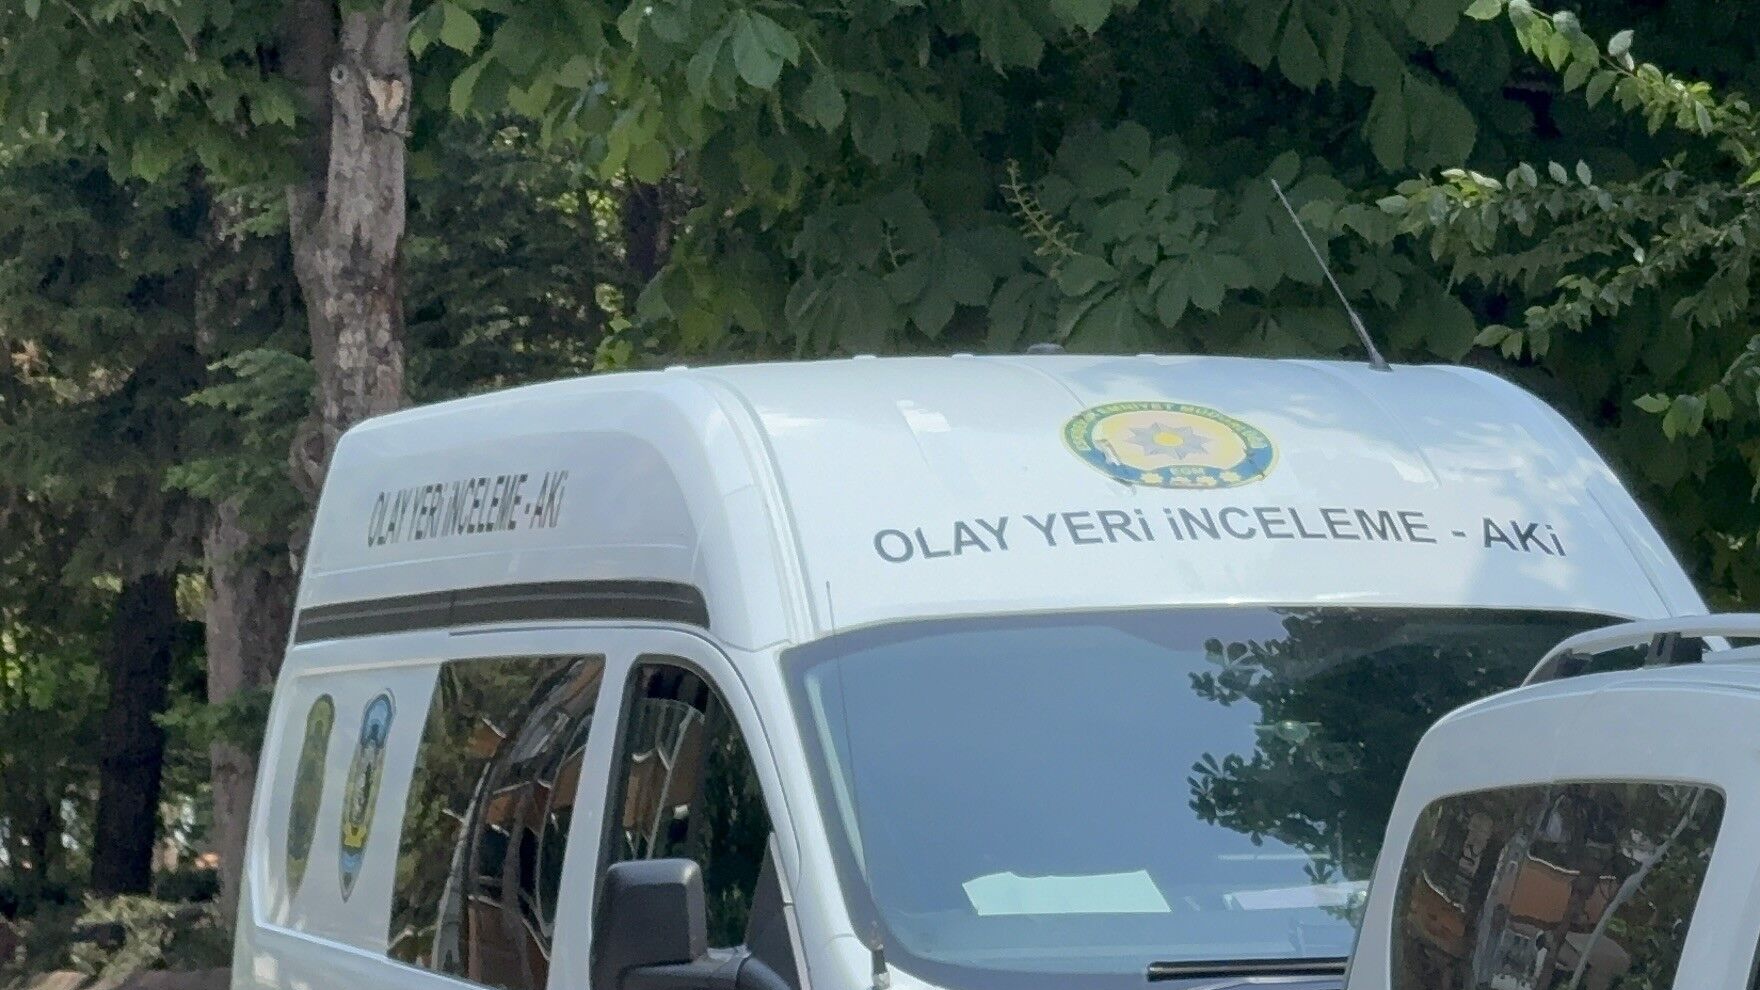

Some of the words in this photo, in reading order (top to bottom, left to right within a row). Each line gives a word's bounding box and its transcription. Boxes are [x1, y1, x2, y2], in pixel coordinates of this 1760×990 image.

[367, 490, 412, 547] OLAY
[873, 516, 1009, 563] OLAY
[1451, 530, 1466, 538] -
